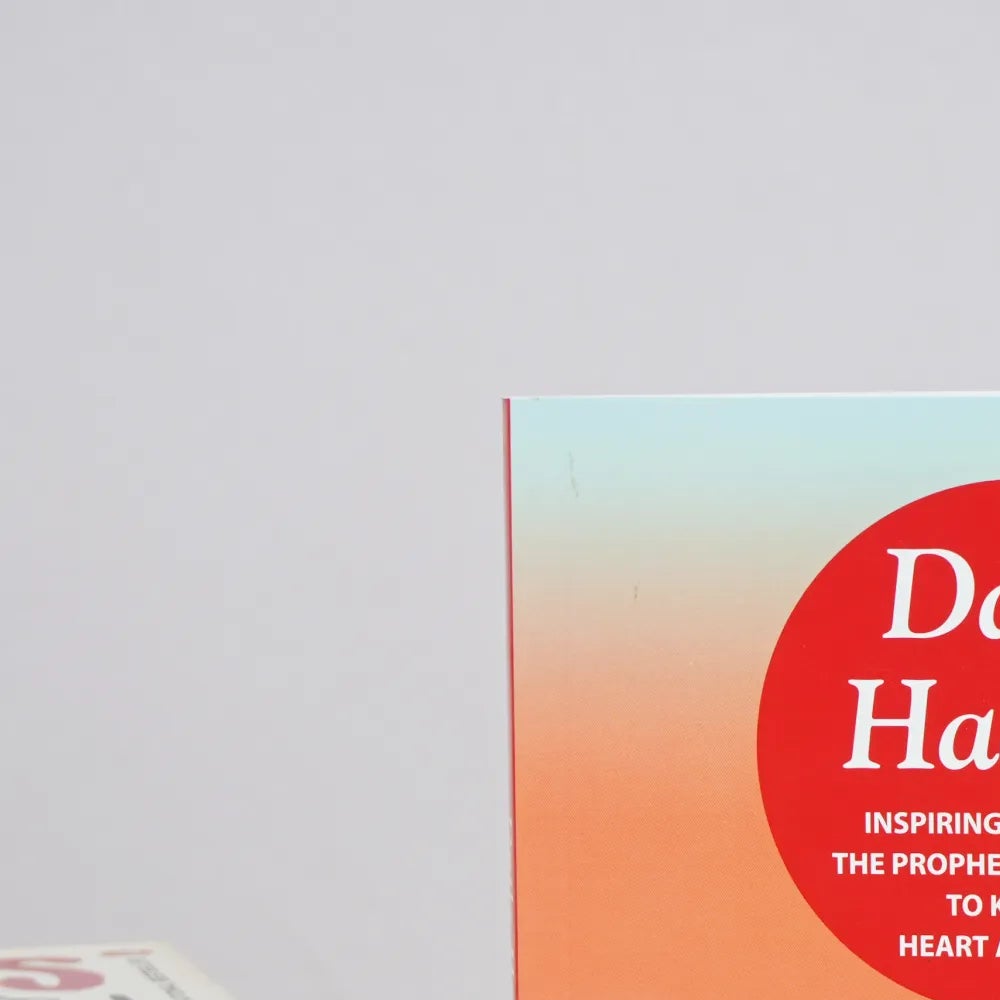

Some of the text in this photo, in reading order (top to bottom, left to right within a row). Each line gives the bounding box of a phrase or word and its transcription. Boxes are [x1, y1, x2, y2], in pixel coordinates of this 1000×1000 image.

[832, 852, 885, 875] THE
[946, 893, 983, 917] TO
[899, 935, 990, 958] HEART
